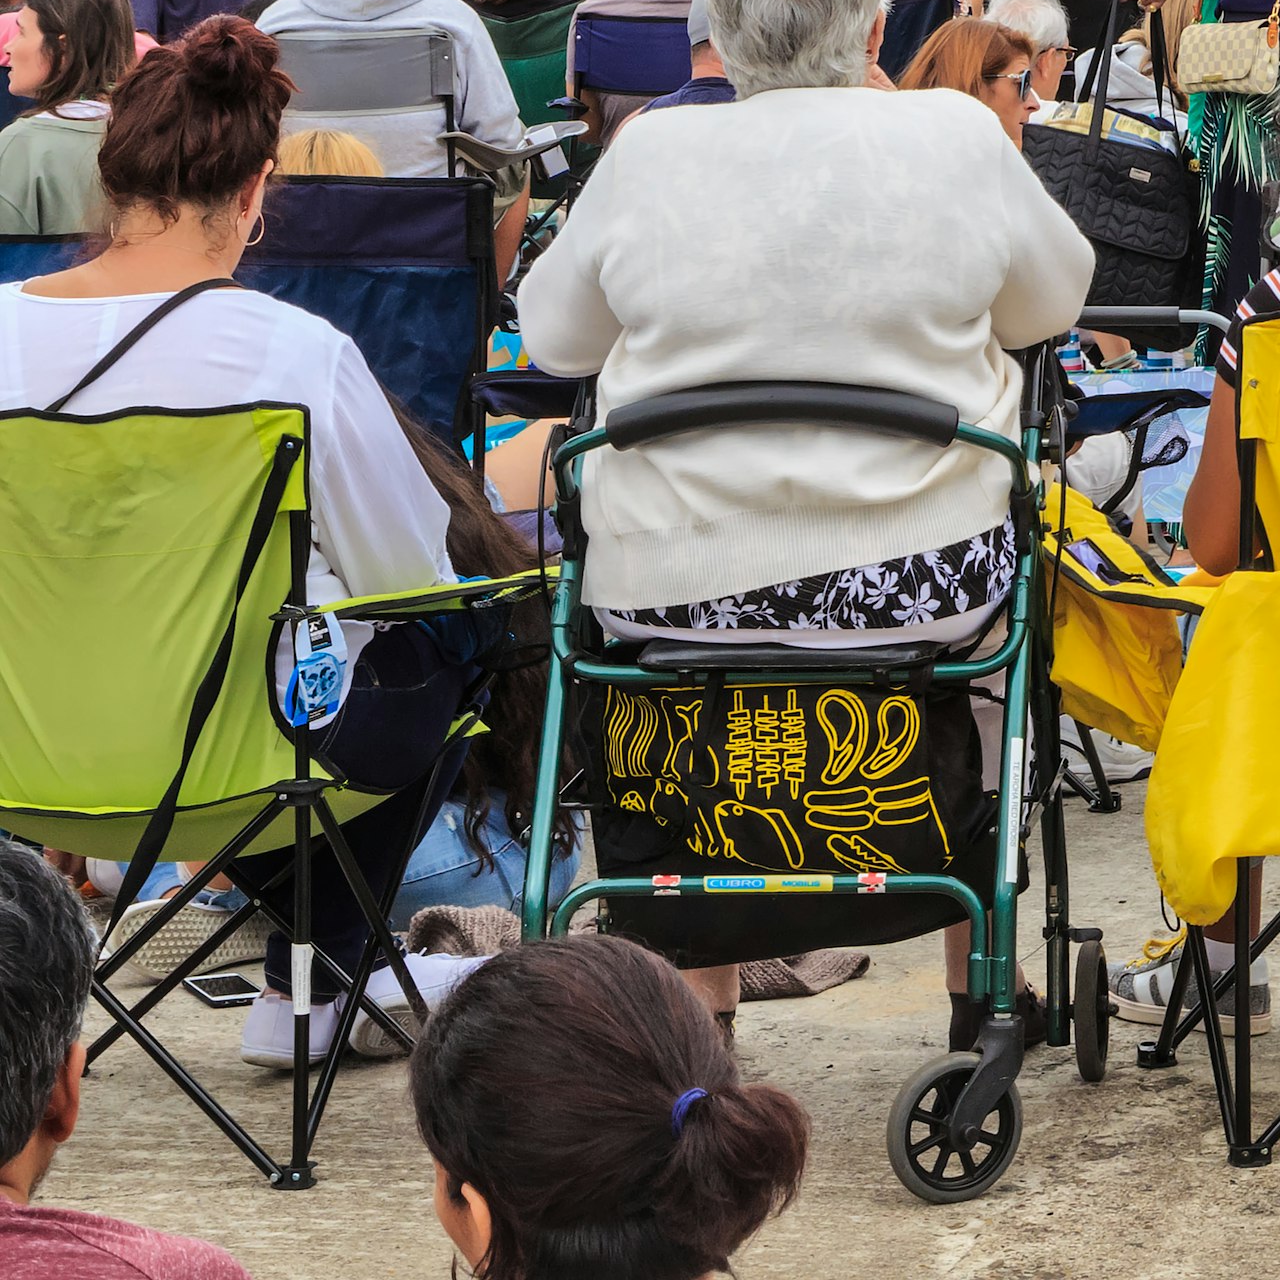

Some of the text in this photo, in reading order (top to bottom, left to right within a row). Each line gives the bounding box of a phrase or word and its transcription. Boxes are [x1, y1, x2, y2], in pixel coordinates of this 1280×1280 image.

[1010, 801, 1018, 819] RED
[1009, 820, 1017, 848] CROSS
[709, 879, 763, 888] CUBRO
